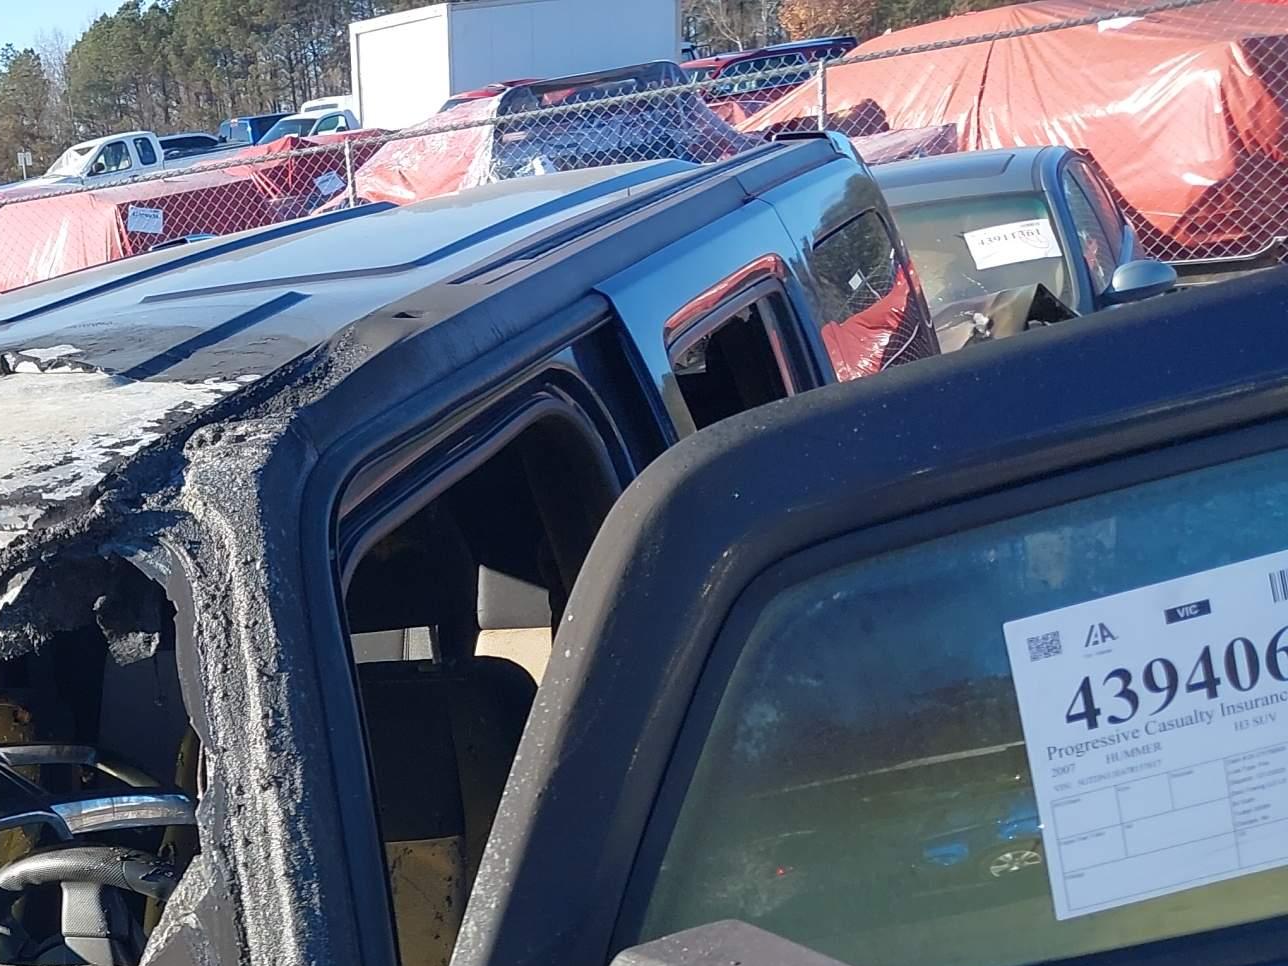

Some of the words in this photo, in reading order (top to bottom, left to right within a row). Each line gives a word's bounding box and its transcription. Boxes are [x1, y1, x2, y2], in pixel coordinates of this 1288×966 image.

[1176, 604, 1199, 618] VIC
[1065, 625, 1288, 730] 439406
[1047, 727, 1140, 761] Progressive
[1144, 707, 1215, 737] Casualty
[1220, 690, 1288, 717] Insuranc
[1052, 763, 1076, 778] 2007
[1105, 742, 1162, 764] HUMMER
[1252, 711, 1278, 727] SUV
